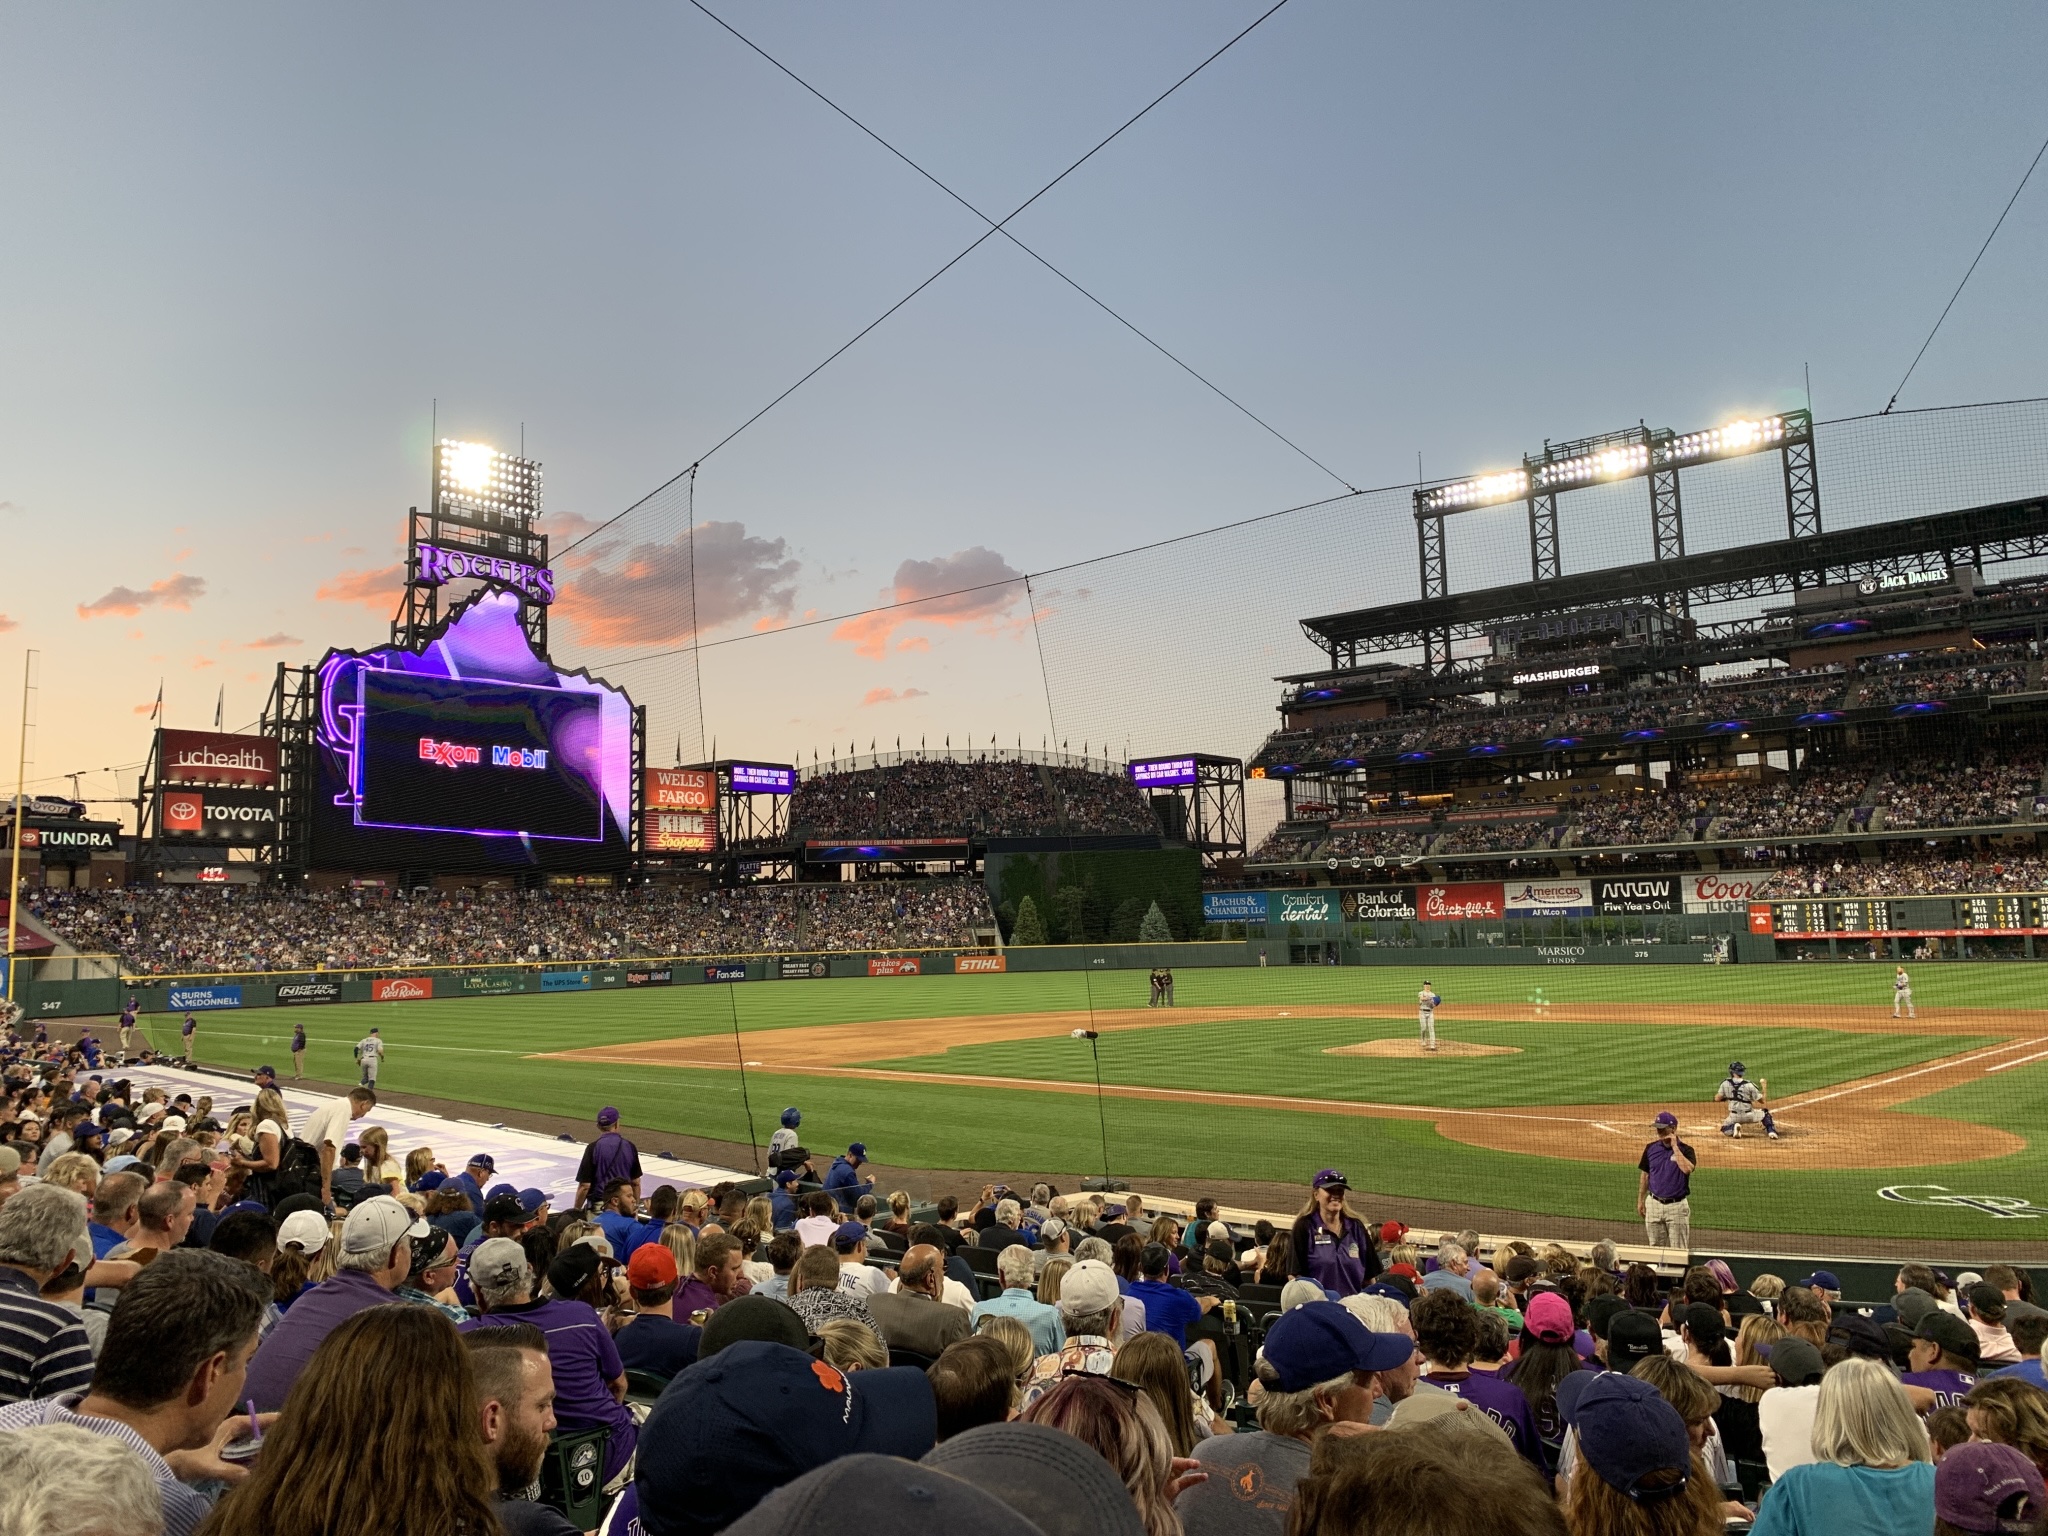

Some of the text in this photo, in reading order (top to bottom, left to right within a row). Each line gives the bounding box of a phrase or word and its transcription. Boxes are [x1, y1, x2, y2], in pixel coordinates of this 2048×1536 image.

[416, 545, 556, 604] ROCKIES
[1880, 575, 1907, 588] JACK
[1908, 568, 1949, 585] DANIEL'S
[1486, 609, 1639, 646] THE ROOFTOP
[1513, 665, 1600, 684] SMASHBURGER
[179, 745, 264, 770] uchealth
[420, 738, 546, 768] Exxon Mobil
[657, 772, 705, 788] WELLS
[658, 789, 705, 805] FARGO
[204, 805, 274, 822] TOYOTA
[658, 815, 705, 833] KING
[39, 831, 113, 846] TUNDRA
[657, 832, 705, 848] Soopers
[1602, 881, 1670, 898] ARROW
[1695, 875, 1754, 899] Coor
[1212, 896, 1257, 907] BACHUS &
[1283, 892, 1325, 905] Comfort
[1358, 890, 1403, 904] Bank of
[1204, 905, 1266, 915] SCHANKER LLC
[1359, 905, 1416, 918] Colorado
[1624, 901, 1651, 910] Yeas
[1710, 900, 1746, 911] LIGH
[1538, 947, 1585, 956] MARSICO
[872, 959, 900, 967] brakes
[960, 959, 1001, 970] STIHL
[717, 969, 745, 979] Fanatics
[875, 967, 894, 975] plus
[181, 991, 213, 999] BURNS
[298, 988, 338, 996] NERVE
[380, 986, 424, 998] Red Robin
[41, 1001, 61, 1010] 347
[578, 1472, 590, 1482] 10
